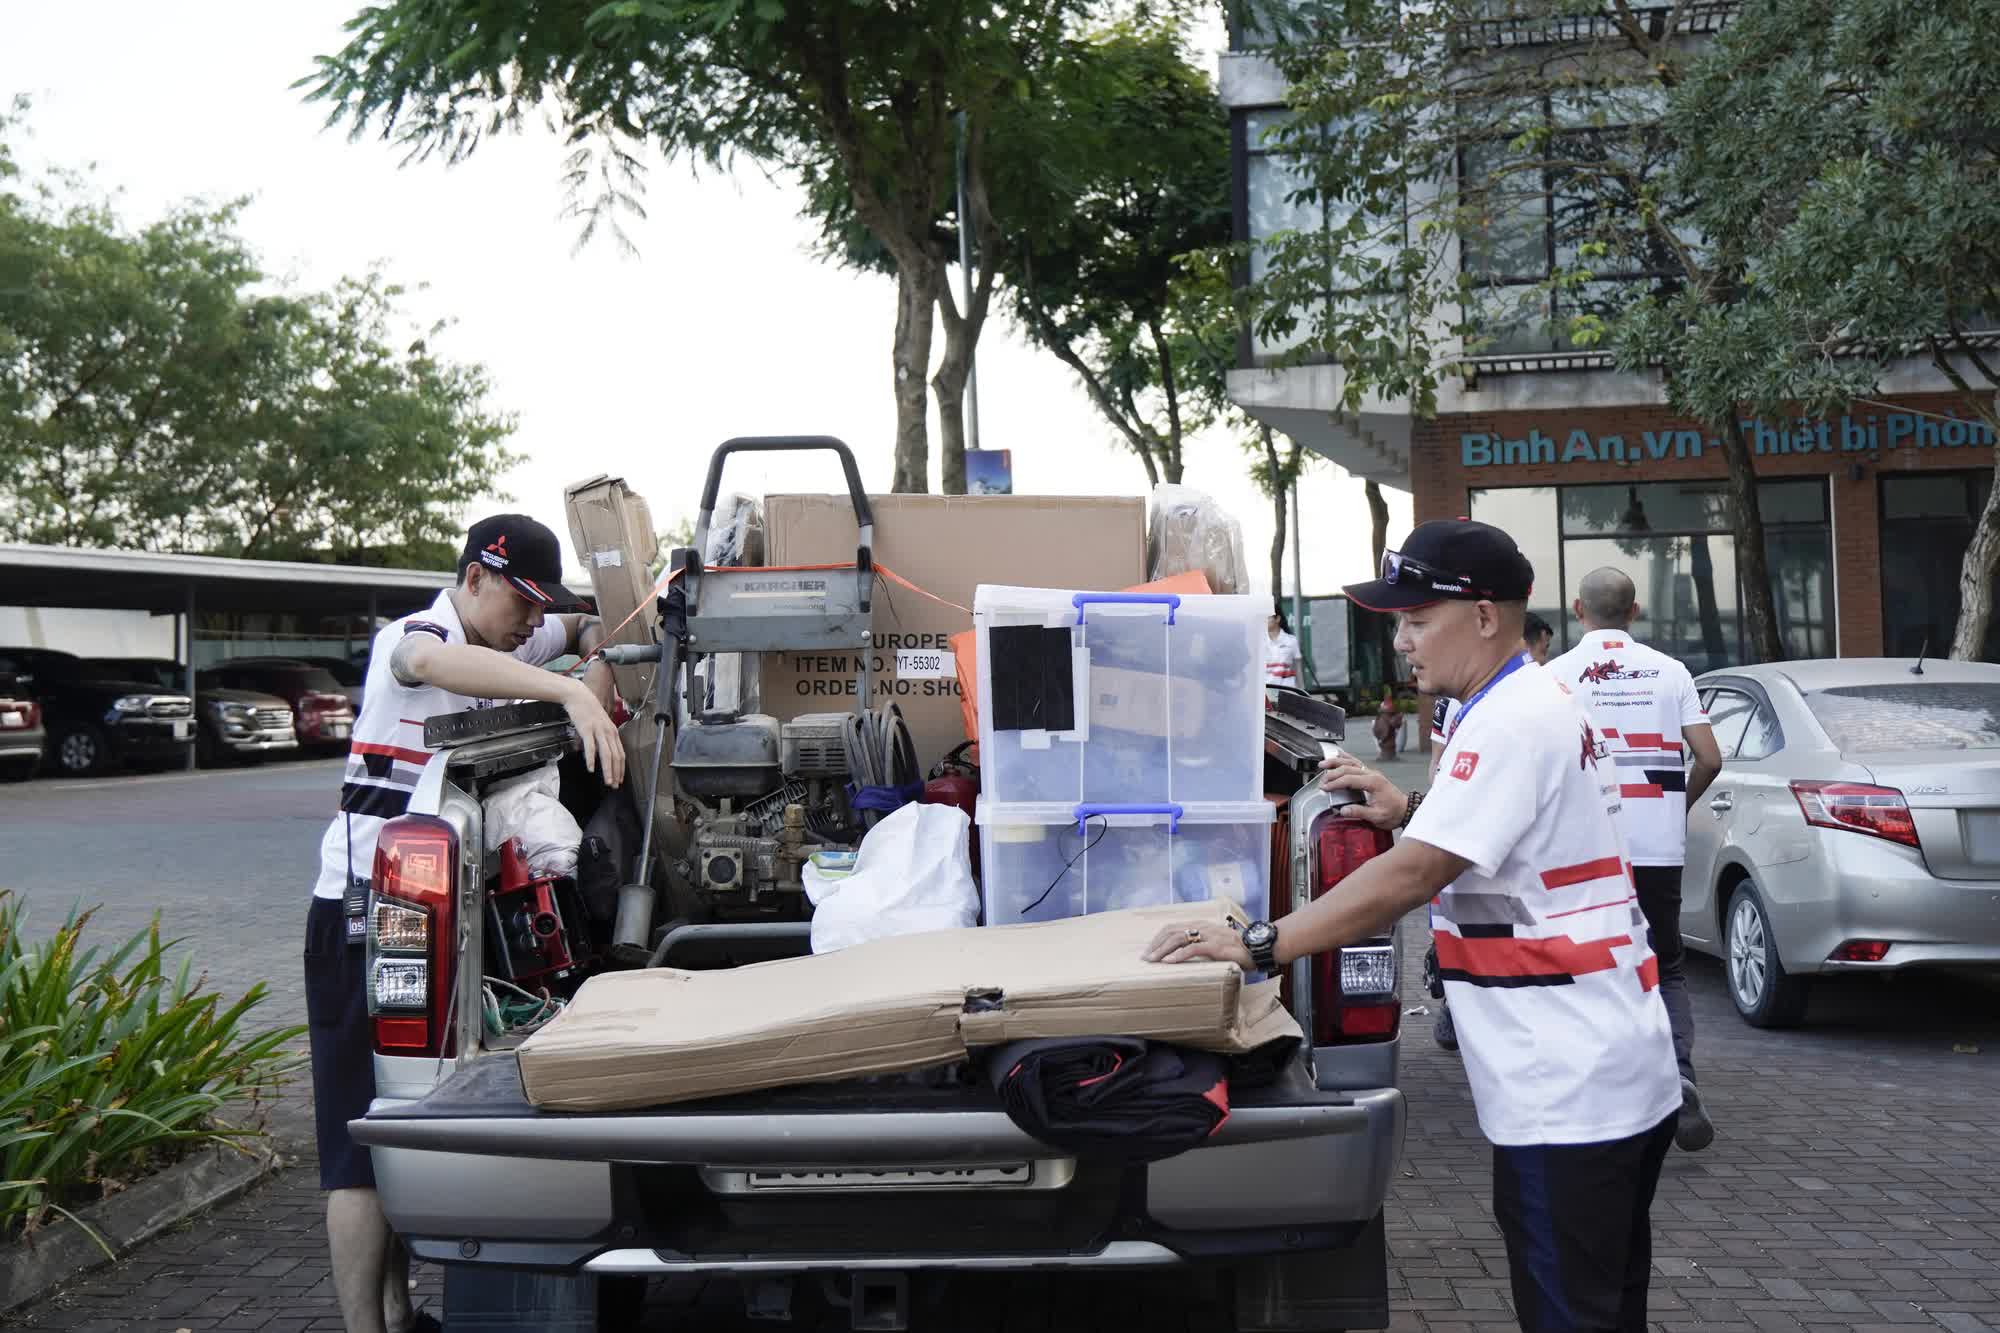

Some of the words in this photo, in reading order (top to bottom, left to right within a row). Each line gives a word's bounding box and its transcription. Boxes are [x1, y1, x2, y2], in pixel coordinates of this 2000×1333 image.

[1887, 408, 1994, 449] Phòn
[872, 633, 948, 650] UROPE
[796, 656, 847, 673] ITEM
[899, 655, 941, 671] YT-55302
[796, 679, 877, 696] ORDE
[351, 921, 364, 932] 05
